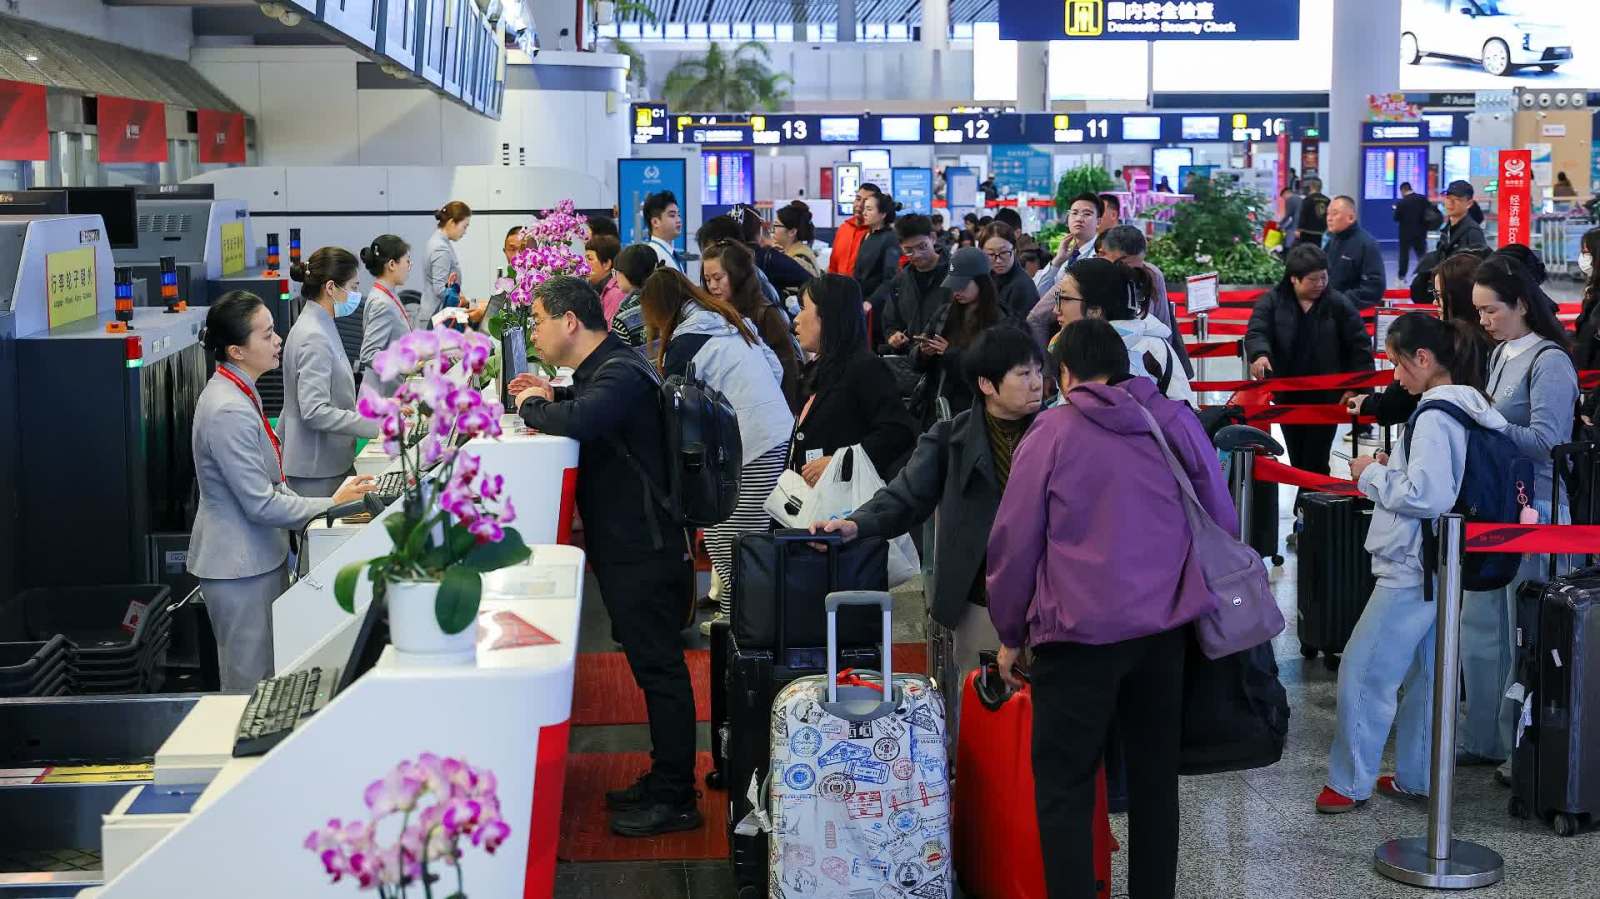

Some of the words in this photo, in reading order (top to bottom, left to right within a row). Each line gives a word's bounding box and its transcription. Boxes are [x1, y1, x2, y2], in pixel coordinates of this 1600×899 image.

[1107, 1, 1214, 20] 国内安全检查
[1107, 21, 1160, 33] Domestic
[1161, 21, 1202, 34] Security
[1203, 21, 1236, 33] Check
[652, 108, 664, 118] C1
[781, 120, 808, 140] 13
[964, 119, 990, 139] 12
[1086, 119, 1108, 138] 11
